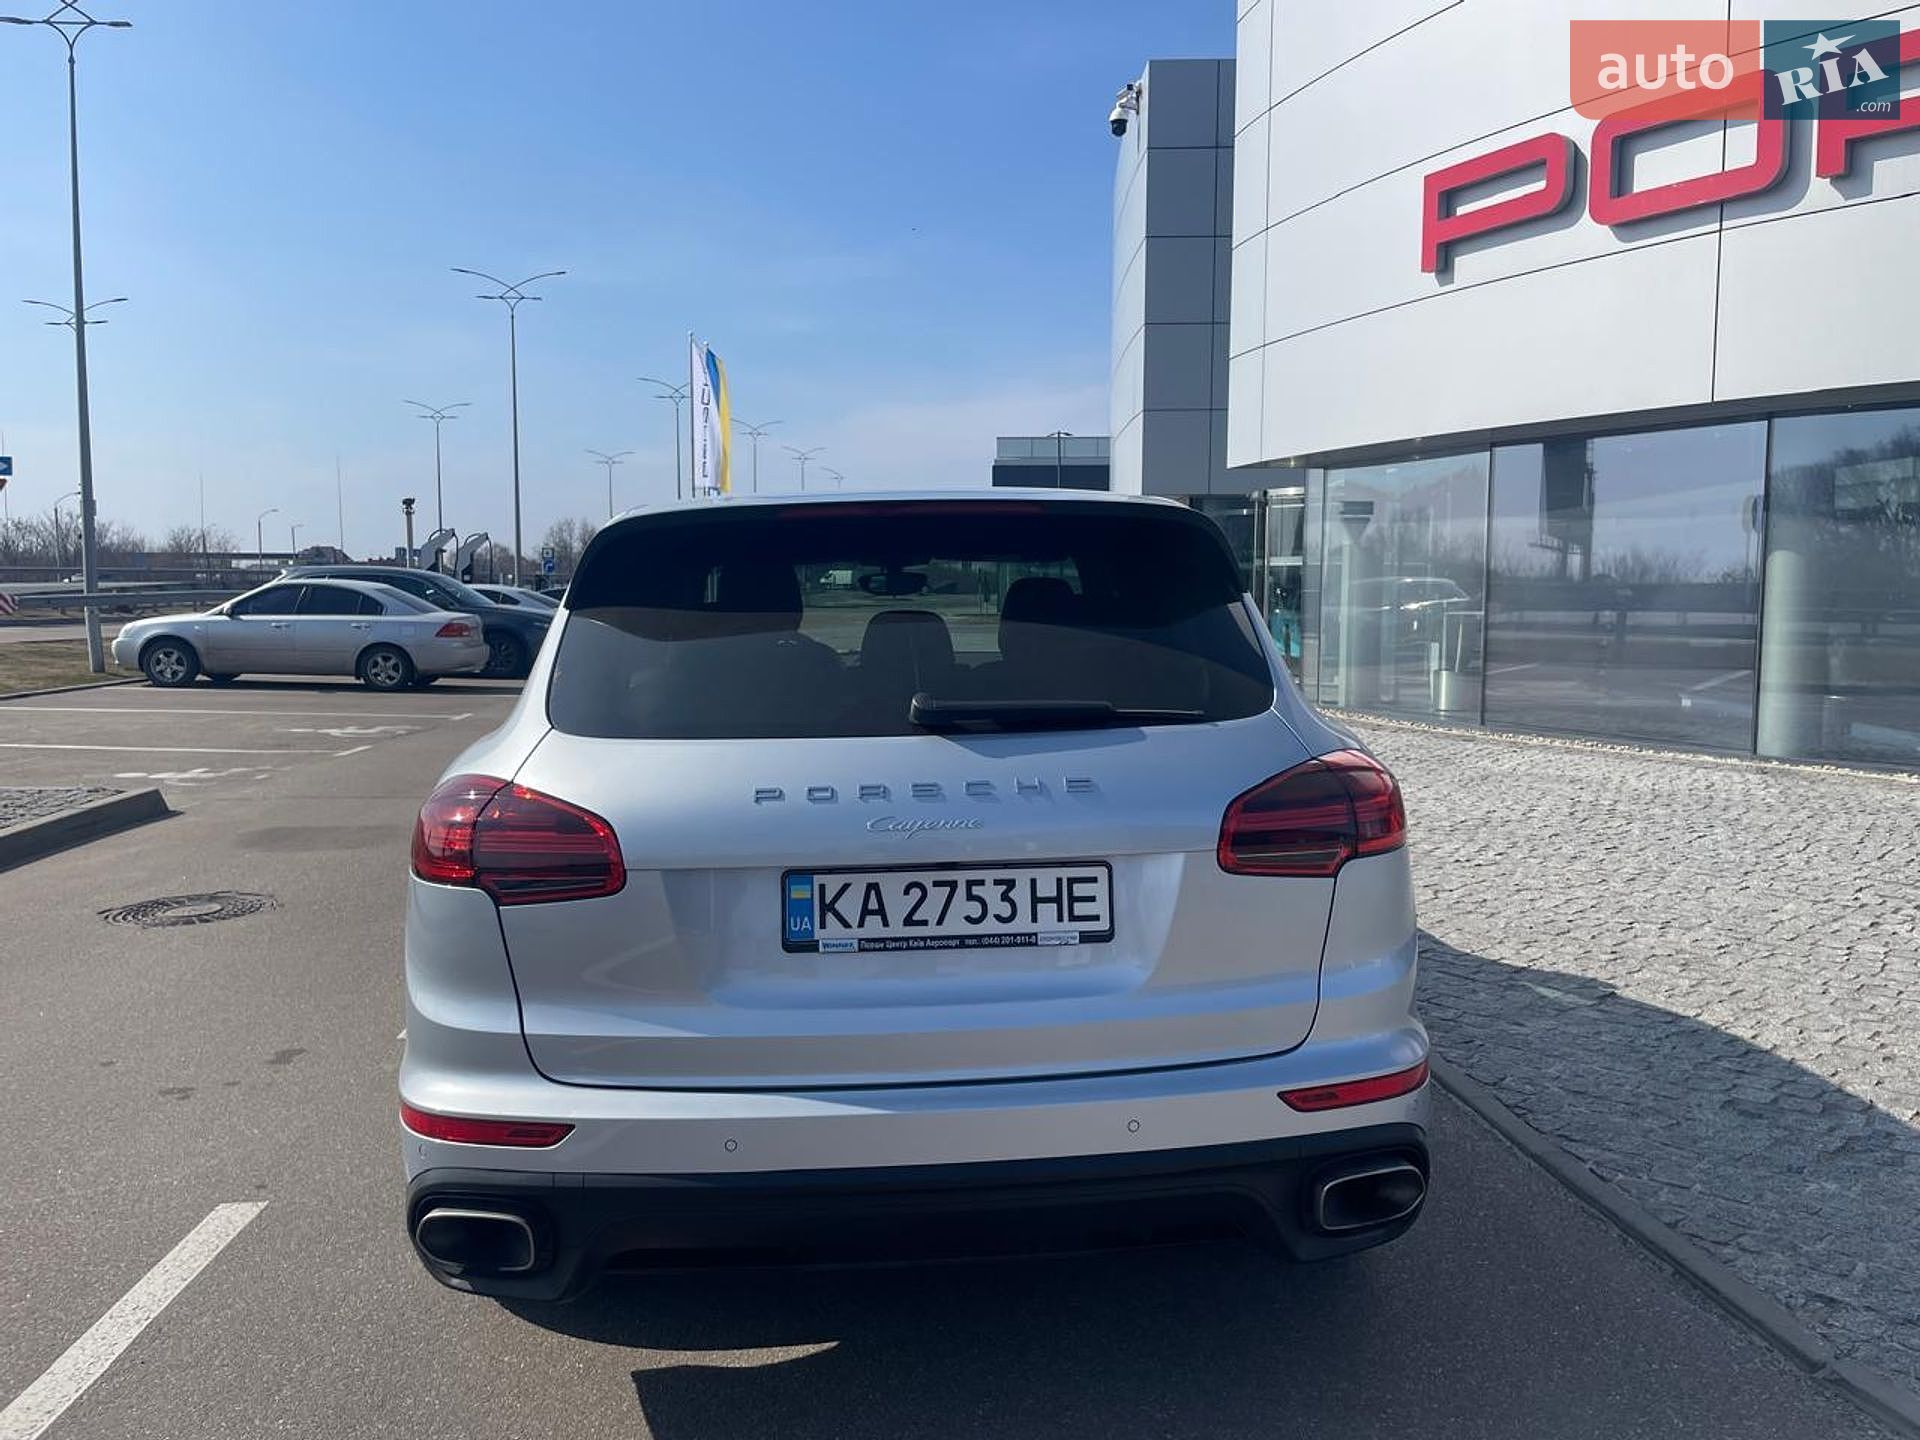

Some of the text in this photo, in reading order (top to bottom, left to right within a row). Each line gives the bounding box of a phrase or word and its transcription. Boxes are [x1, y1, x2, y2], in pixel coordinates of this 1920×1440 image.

[753, 776, 1096, 805] PORSCHE
[866, 815, 985, 839] Cayenne
[818, 875, 1101, 930] KA 2753 HE
[790, 915, 812, 933] UA
